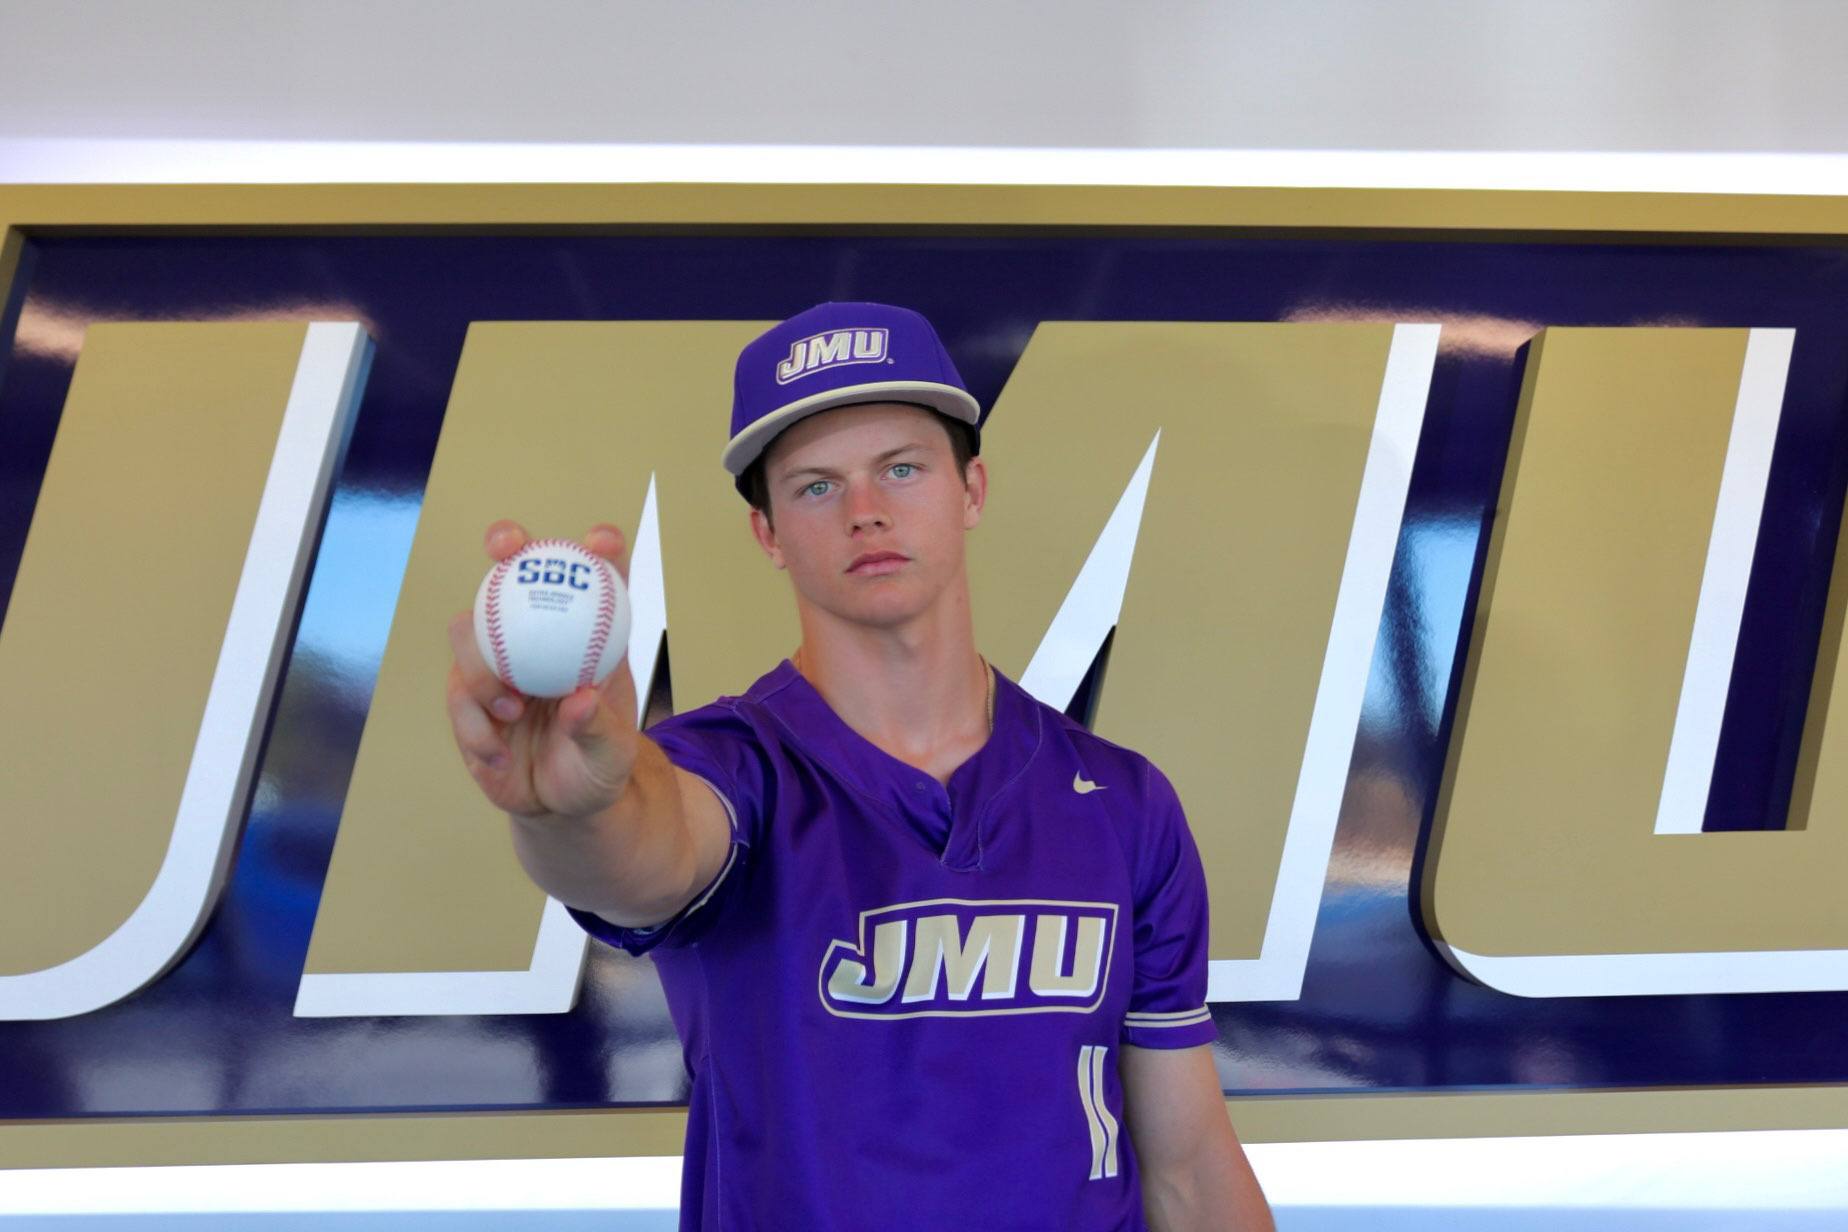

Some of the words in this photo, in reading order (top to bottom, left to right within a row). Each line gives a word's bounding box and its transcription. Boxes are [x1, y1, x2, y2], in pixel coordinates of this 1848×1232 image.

[779, 331, 883, 380] JMU
[518, 558, 592, 591] SBC
[828, 914, 1106, 1004] JMU
[1077, 1045, 1118, 1180] 11
